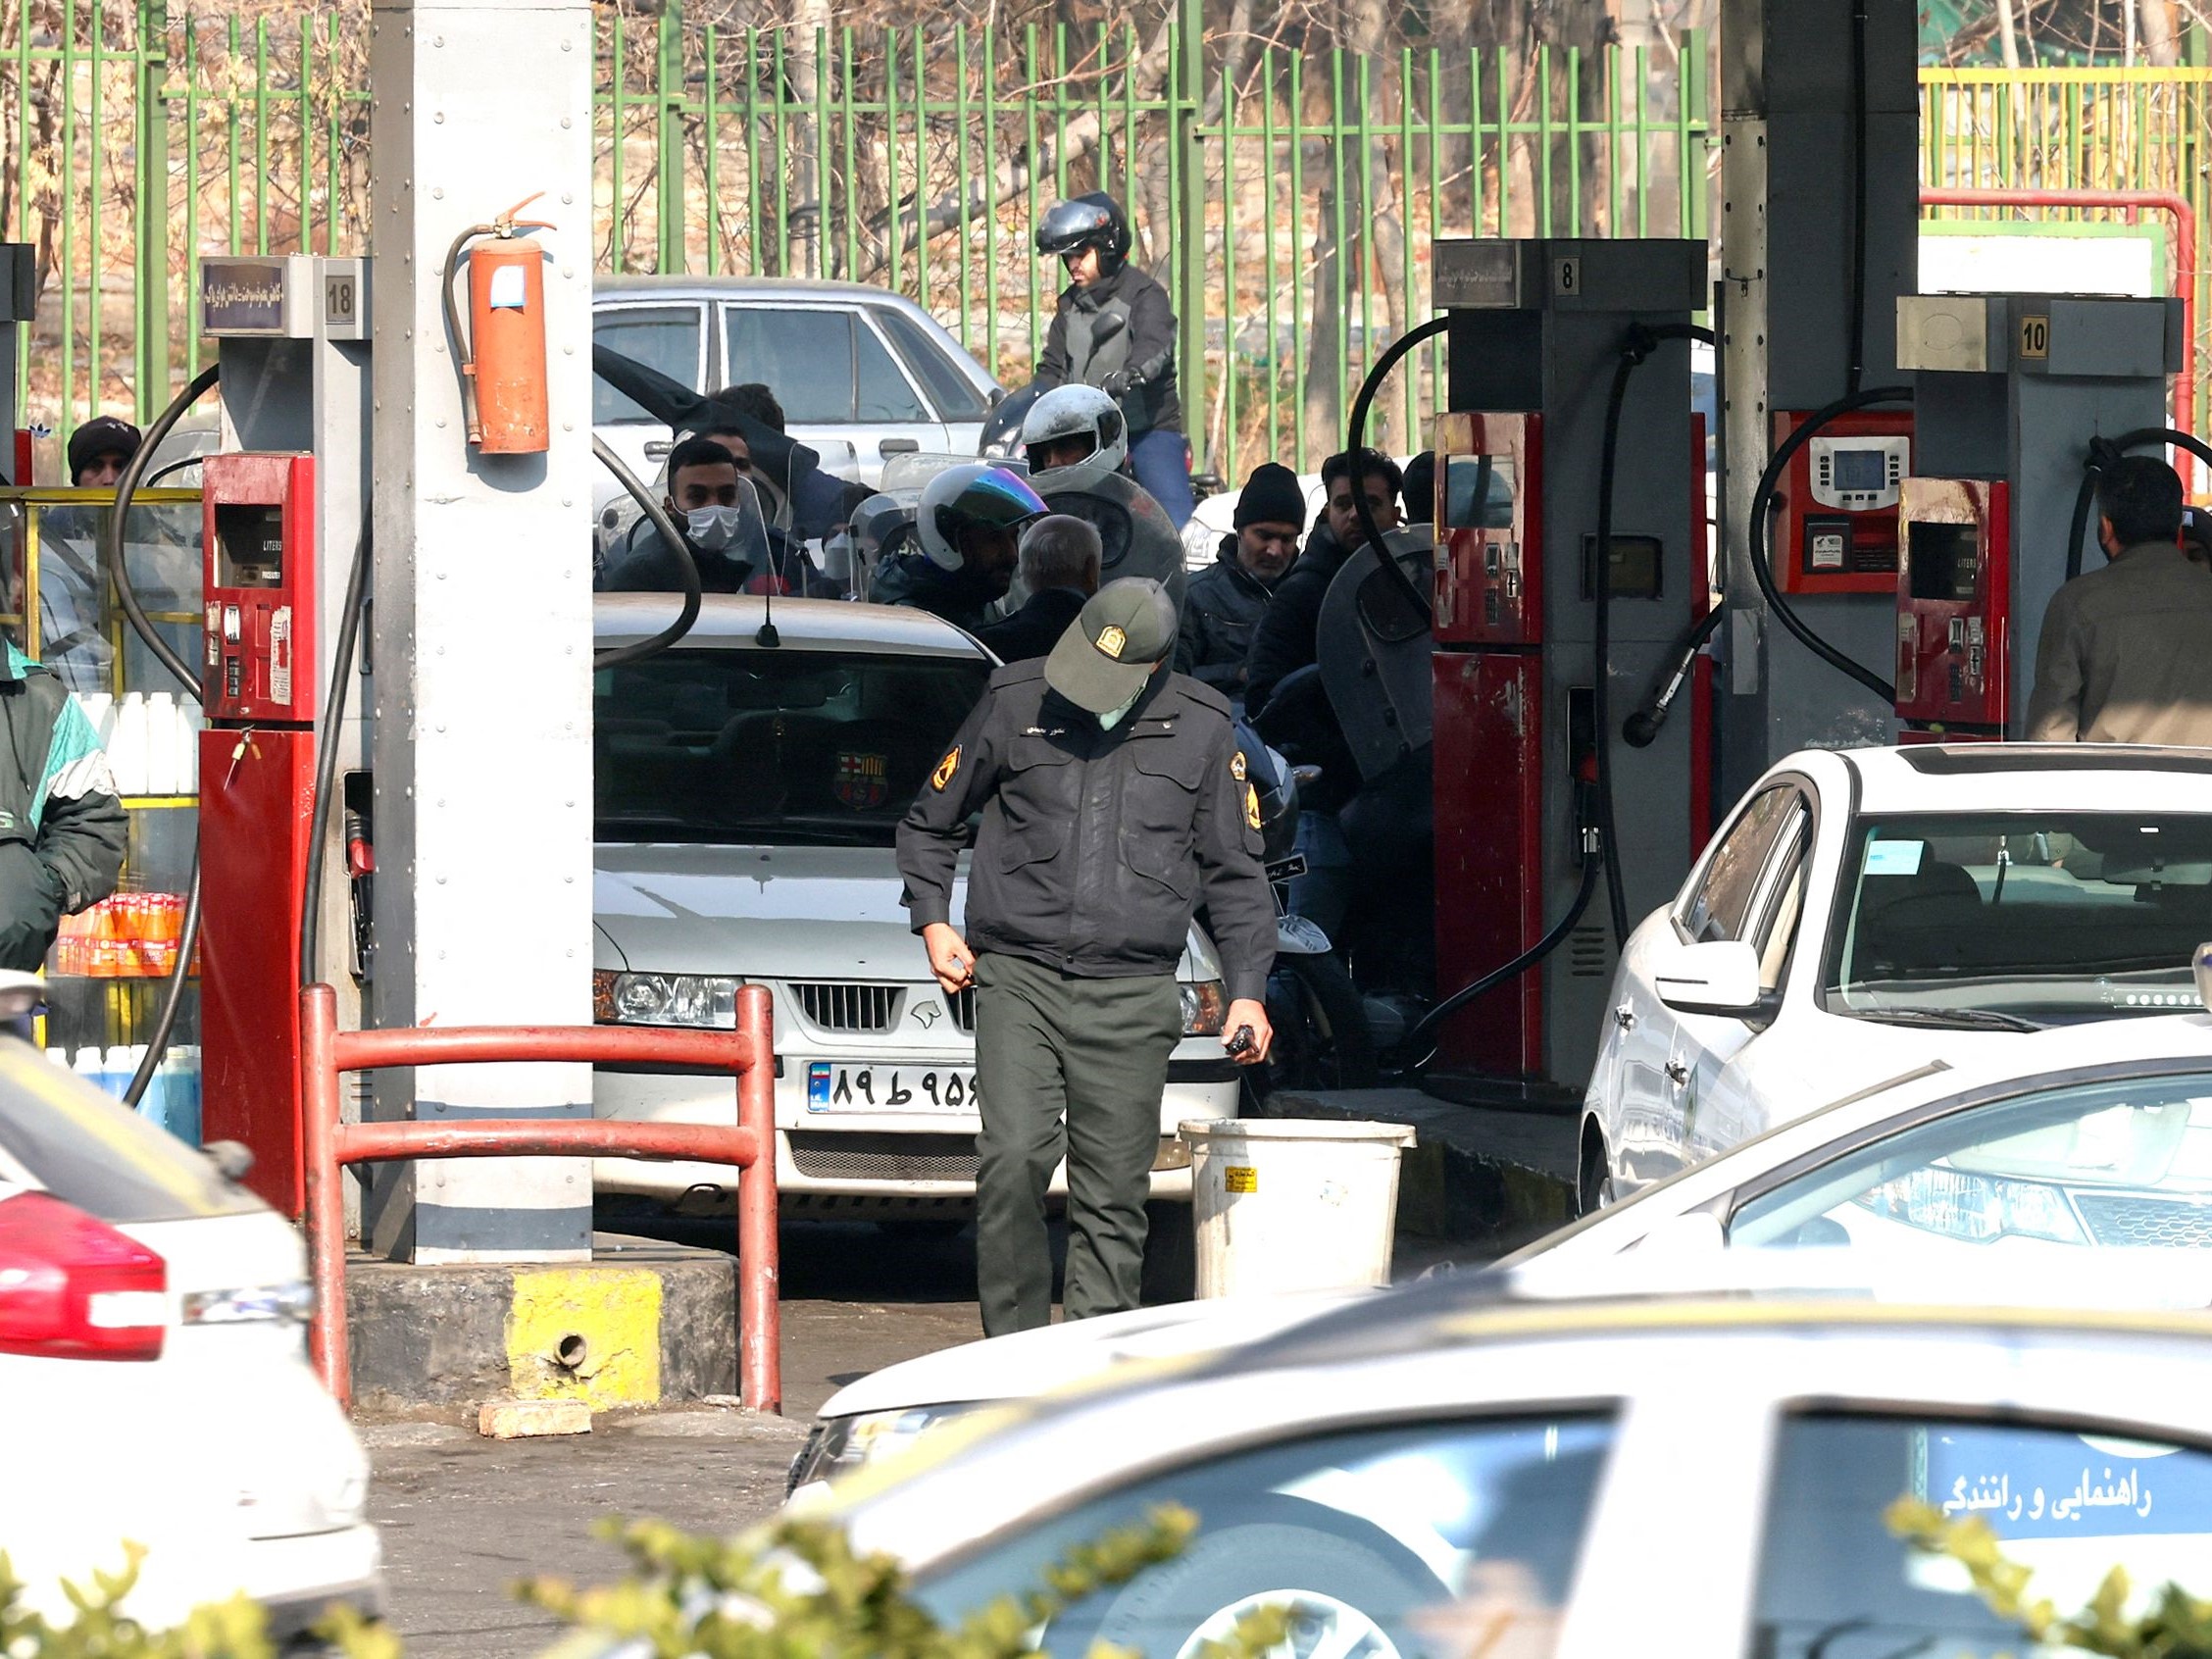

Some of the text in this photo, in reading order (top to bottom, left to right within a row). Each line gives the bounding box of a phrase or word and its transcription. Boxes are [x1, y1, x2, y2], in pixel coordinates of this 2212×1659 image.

[1562, 263, 1574, 288] 8
[328, 283, 351, 314] 18
[2024, 323, 2045, 351] 10
[263, 540, 282, 551] LITERS
[1957, 558, 1977, 569] LITERS
[833, 1069, 876, 1106] ۸۹
[885, 1070, 913, 1106] ط
[2028, 1486, 2044, 1520] و
[2051, 1467, 2152, 1521] راهنمایی
